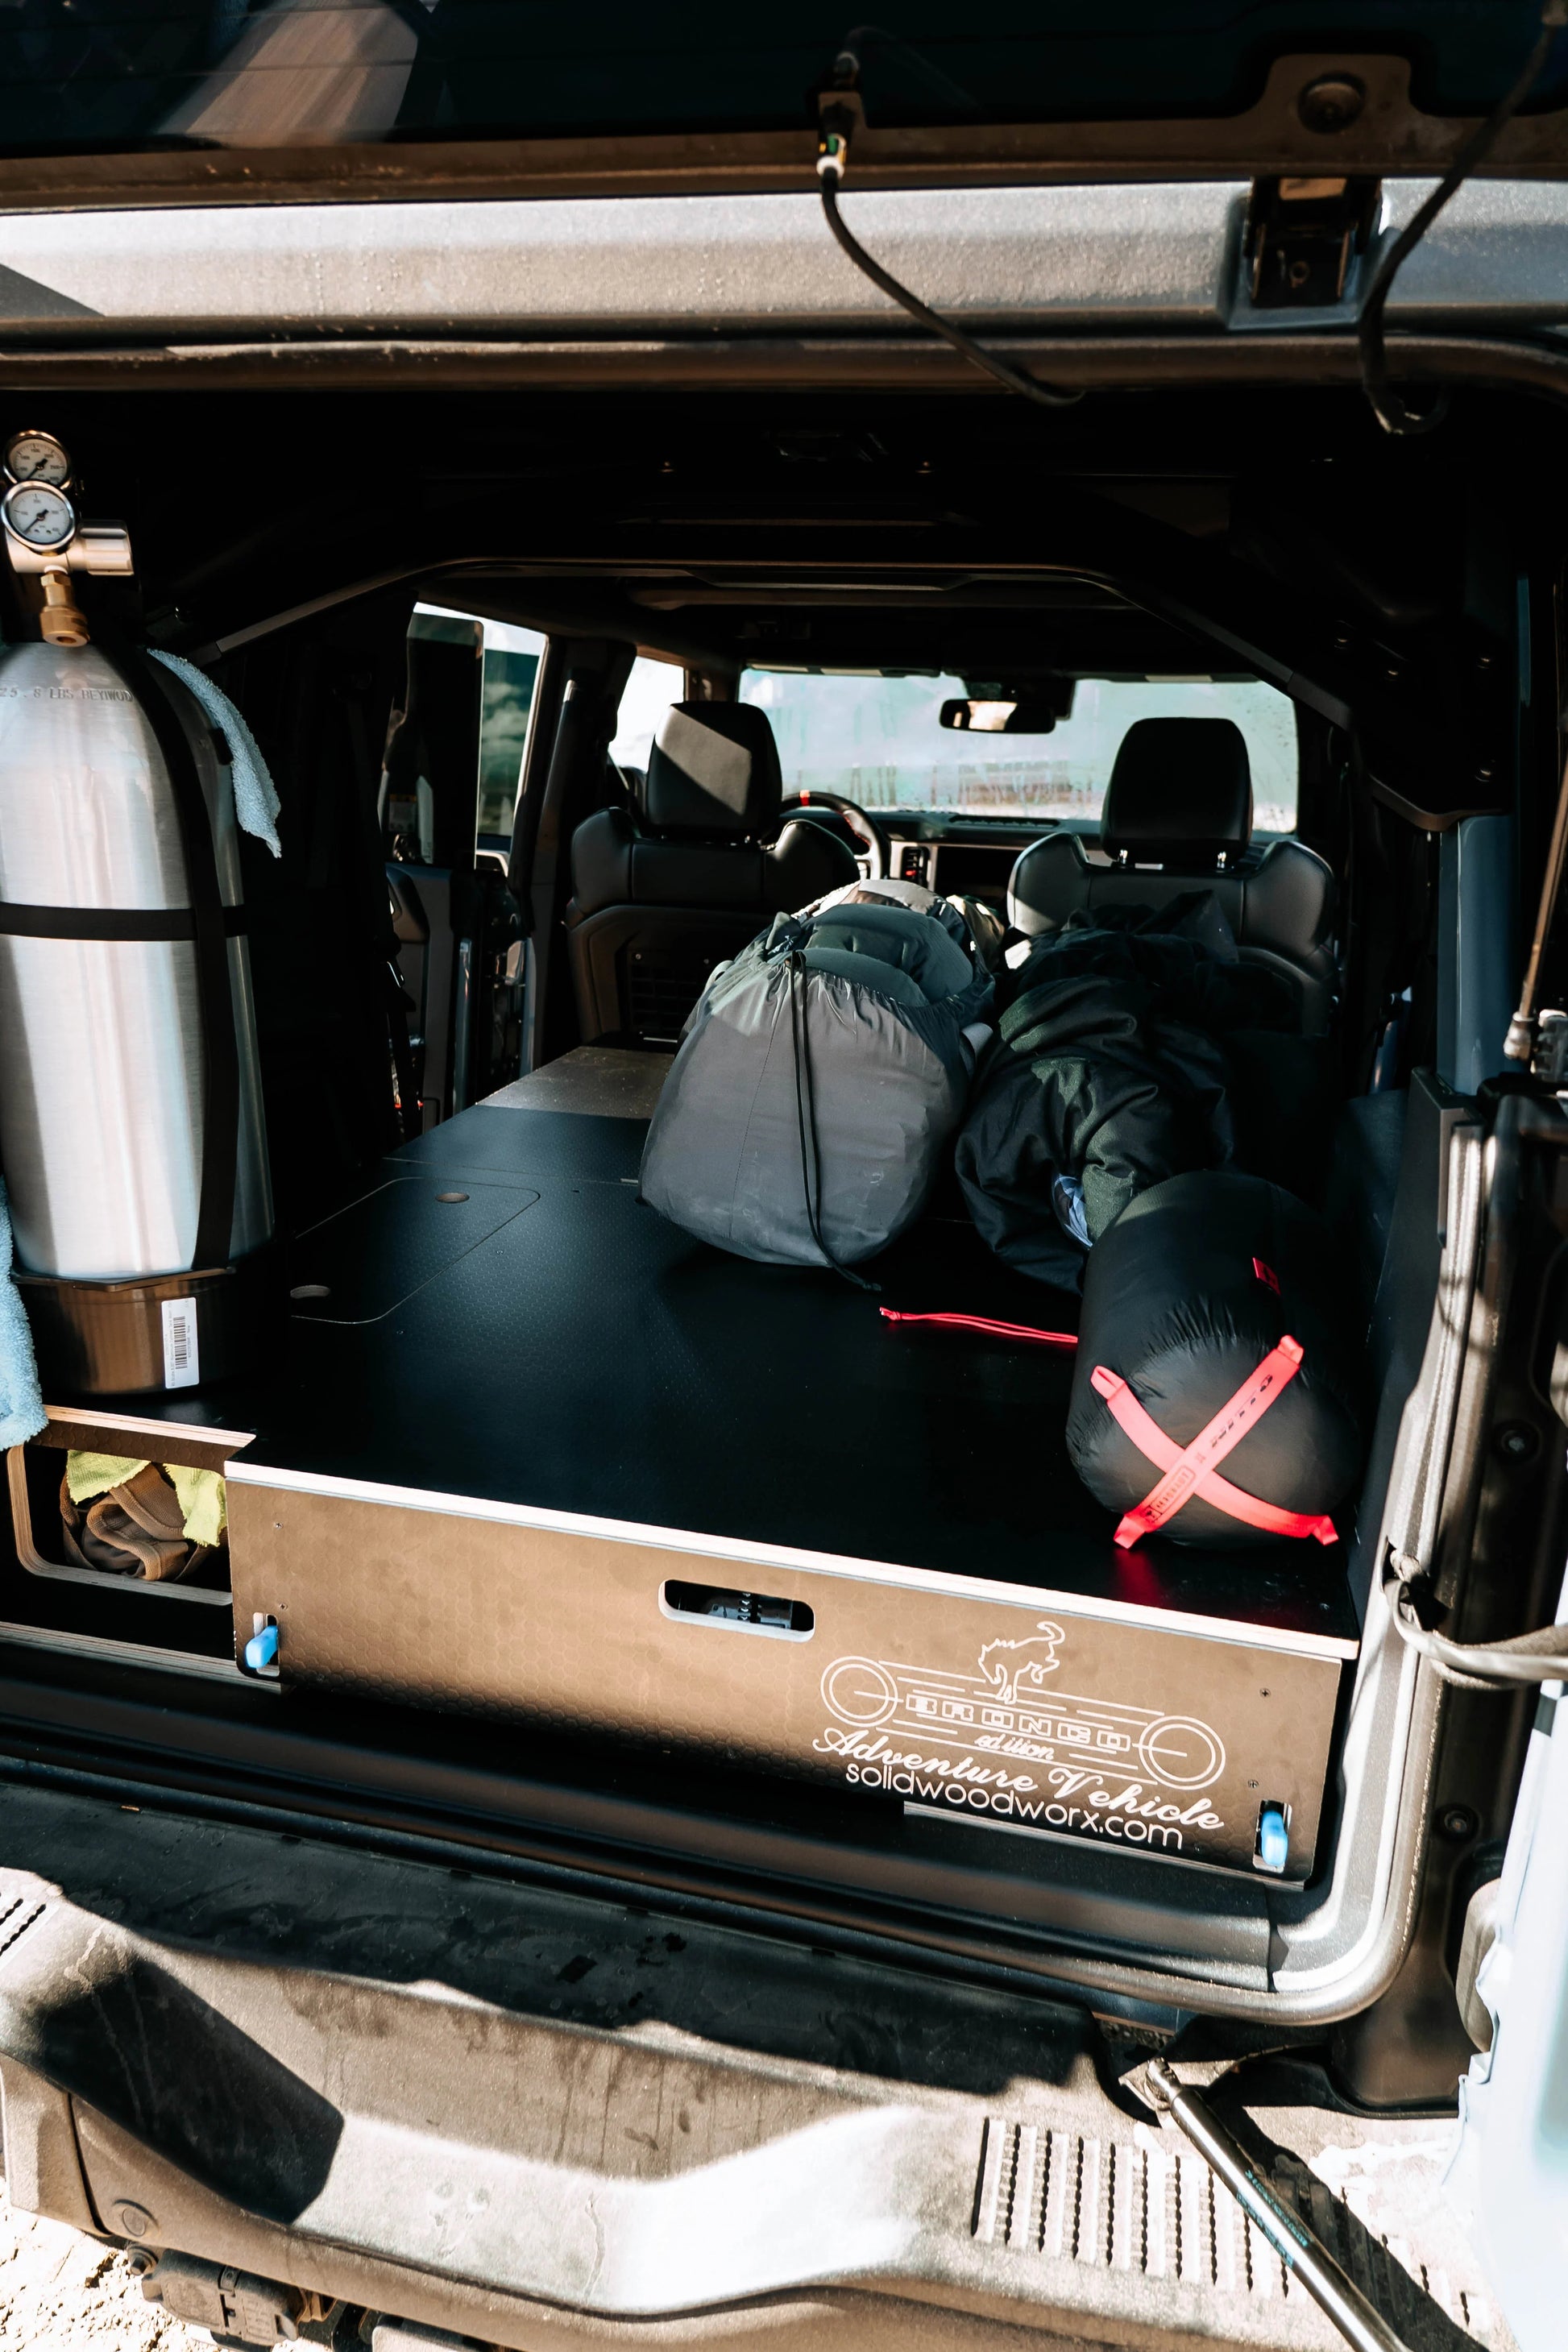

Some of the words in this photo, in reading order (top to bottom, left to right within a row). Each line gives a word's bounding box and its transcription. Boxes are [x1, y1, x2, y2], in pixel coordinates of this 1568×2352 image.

[49, 687, 74, 699] LBS
[906, 1693, 1130, 1752] BRONCO
[974, 1733, 1054, 1760] edition
[812, 1727, 1038, 1791] Adventure
[1047, 1767, 1224, 1829] Vehicle
[846, 1763, 1183, 1849] solidwoodworx.com
